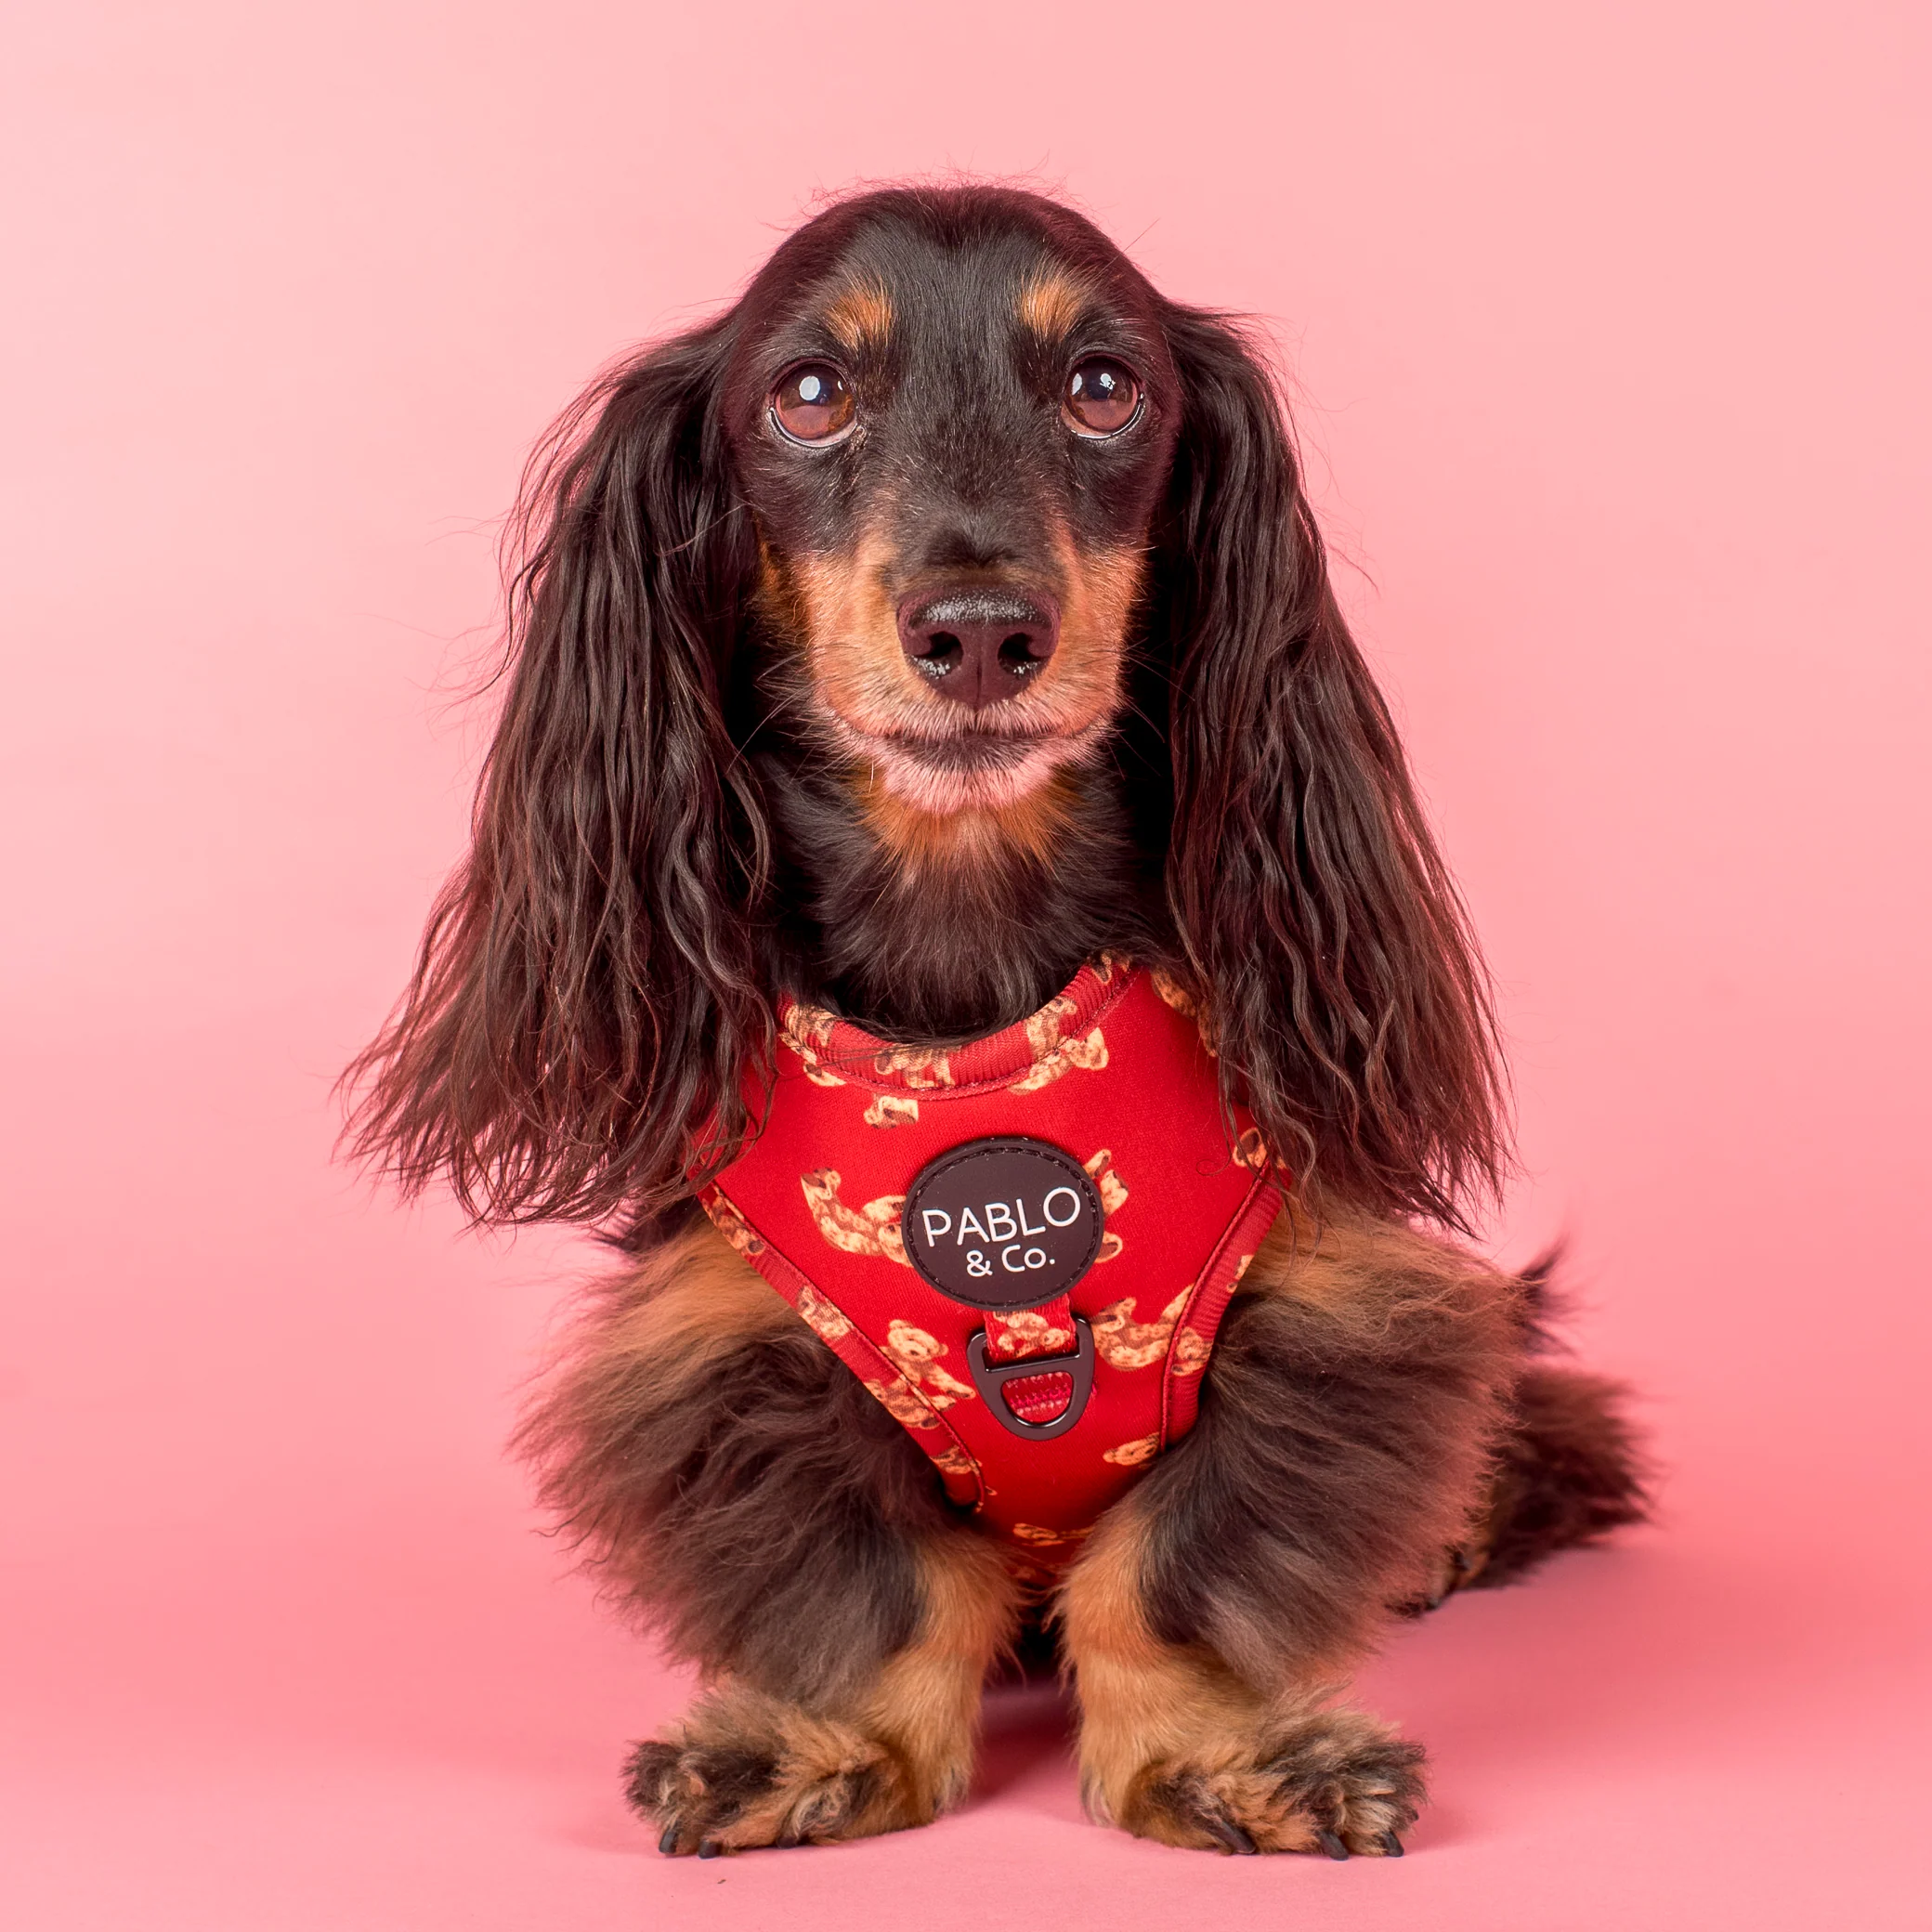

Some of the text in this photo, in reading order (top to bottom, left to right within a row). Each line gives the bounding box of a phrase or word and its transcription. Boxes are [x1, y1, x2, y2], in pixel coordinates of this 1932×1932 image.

[921, 1186, 1081, 1247] PABLO
[966, 1244, 1055, 1277] & Co.
